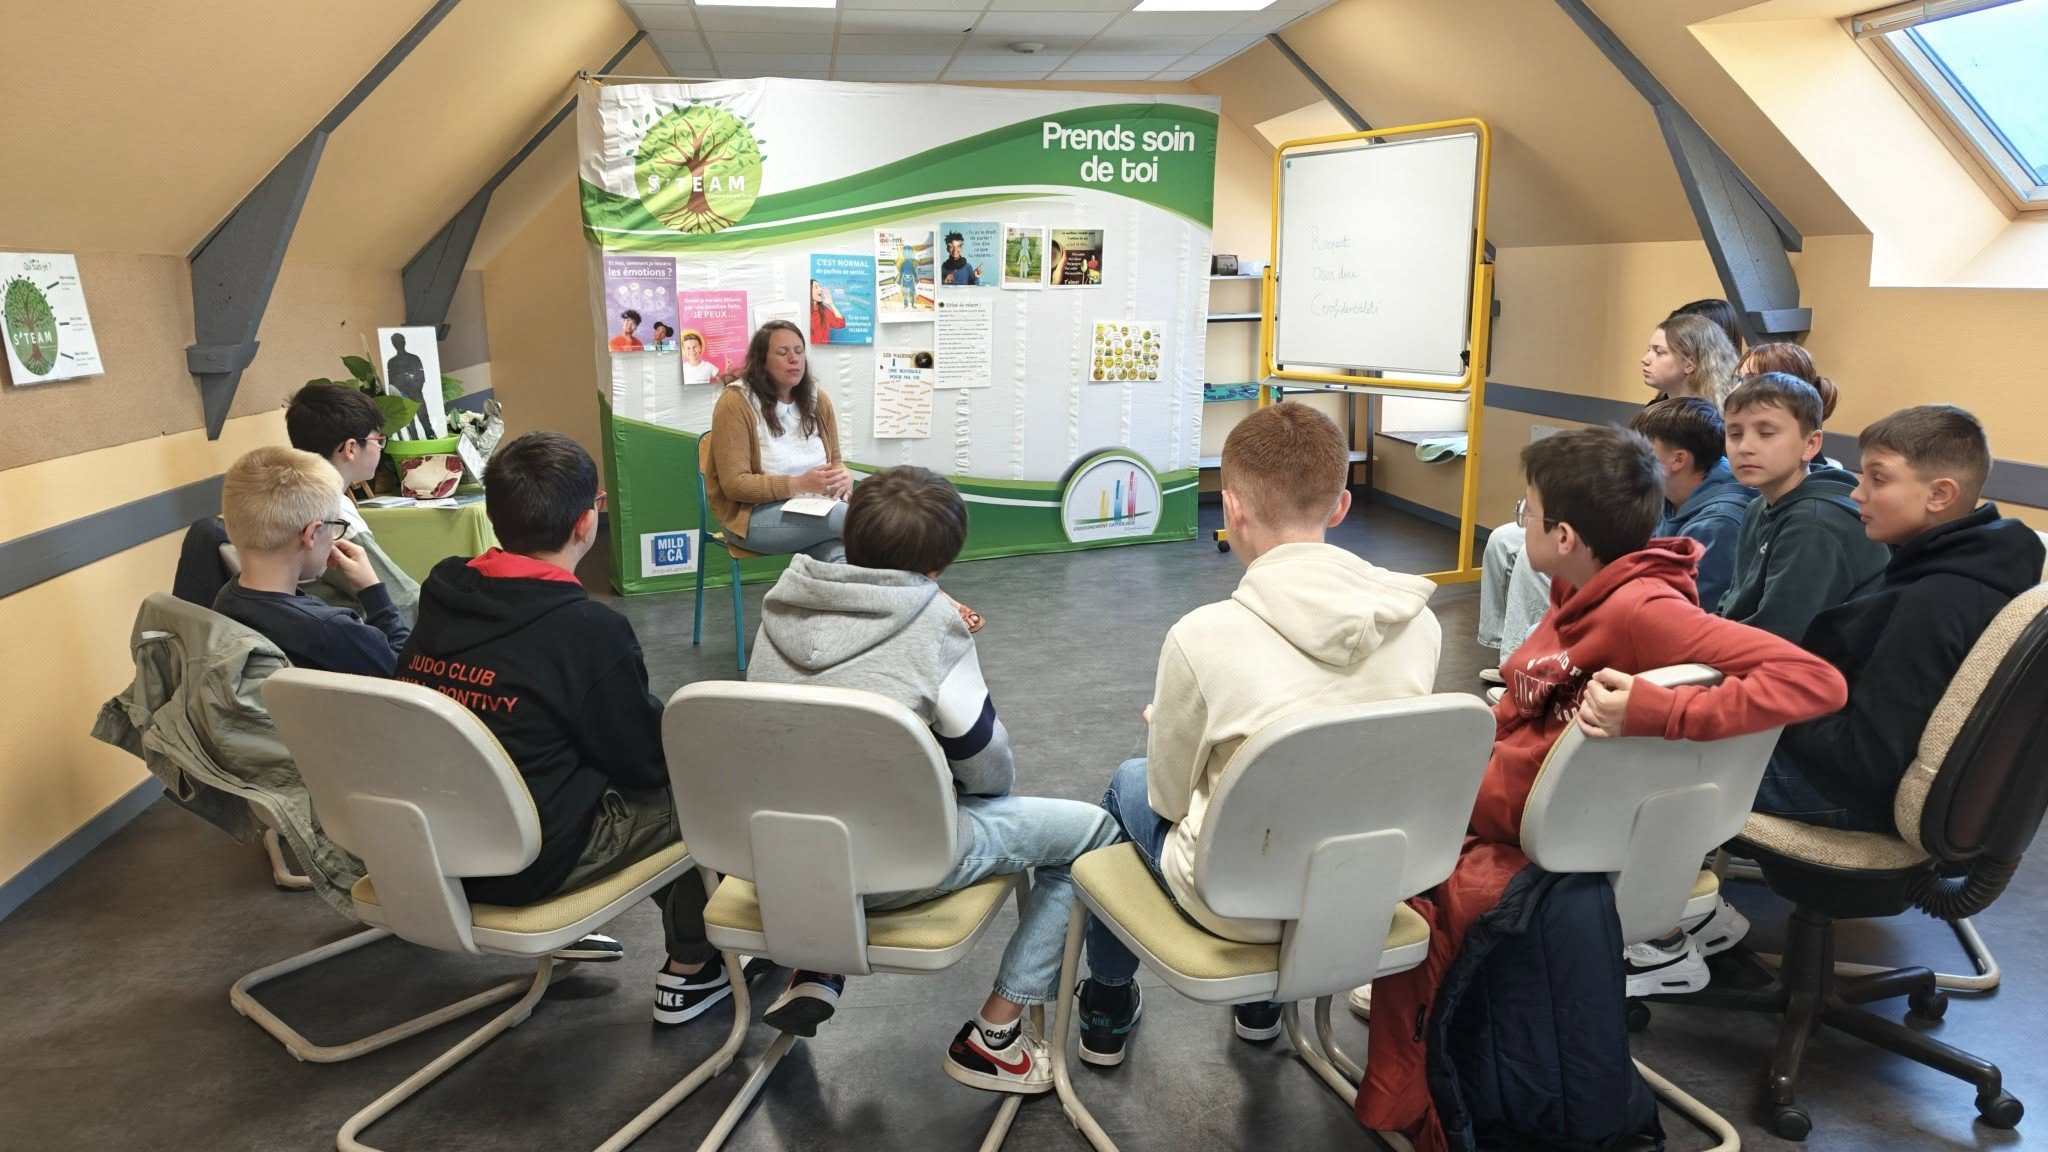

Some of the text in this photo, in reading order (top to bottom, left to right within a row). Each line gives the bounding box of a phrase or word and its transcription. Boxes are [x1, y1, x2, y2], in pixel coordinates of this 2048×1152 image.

[1043, 122, 1195, 151] Prends soin
[1080, 155, 1158, 182] de toi
[816, 258, 869, 268] C'EST NORMAL
[608, 267, 673, 276] les émotions ?
[13, 331, 53, 345] S'TEAM
[657, 537, 684, 550] MILD
[408, 654, 446, 676] JUDO
[449, 662, 496, 687] CLUB
[437, 684, 519, 713] PONTIVY
[655, 988, 684, 1007] IKE
[1092, 1016, 1112, 1028] NIKE
[985, 1027, 1013, 1040] adid
